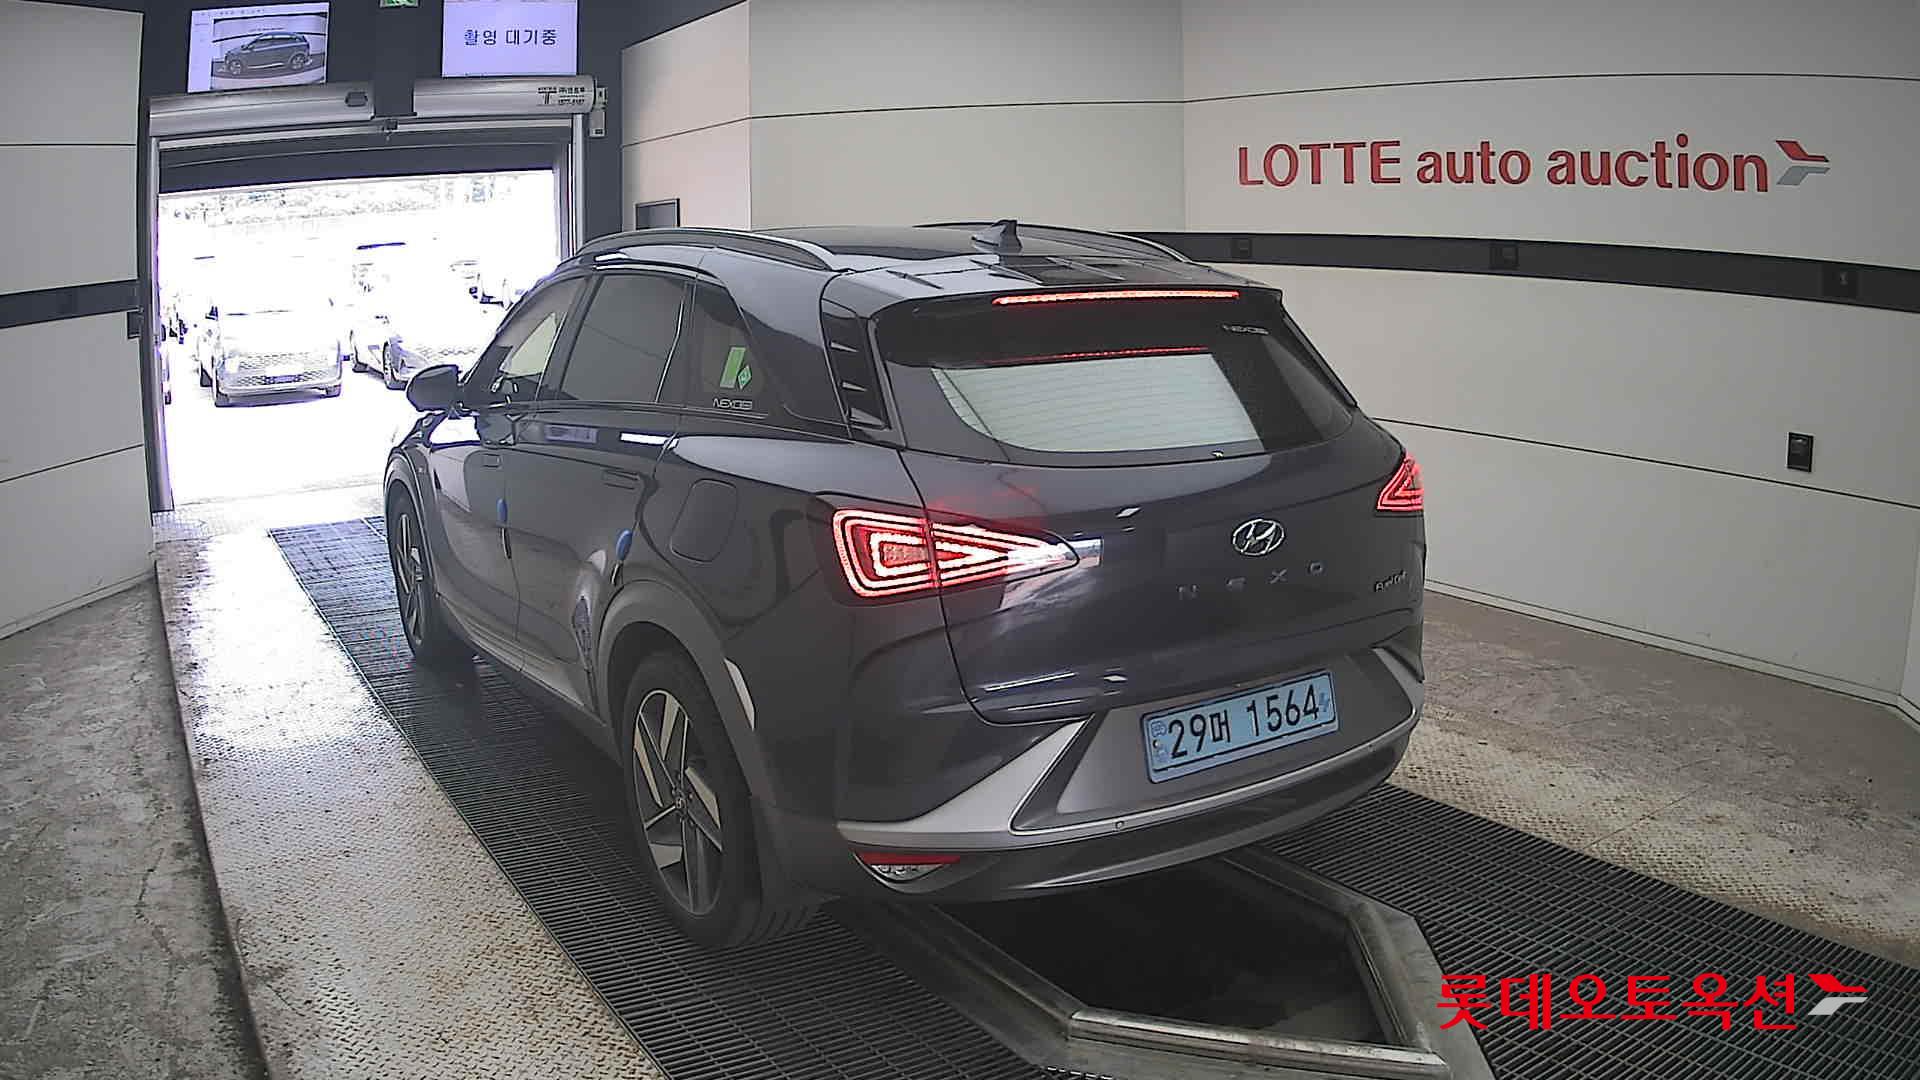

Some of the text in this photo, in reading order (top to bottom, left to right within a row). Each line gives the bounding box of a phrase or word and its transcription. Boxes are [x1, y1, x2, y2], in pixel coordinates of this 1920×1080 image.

[464, 29, 557, 46] 촬영 대기중
[1239, 134, 1768, 192] LOTTE auto auction
[1168, 684, 1320, 760] 29머 1564
